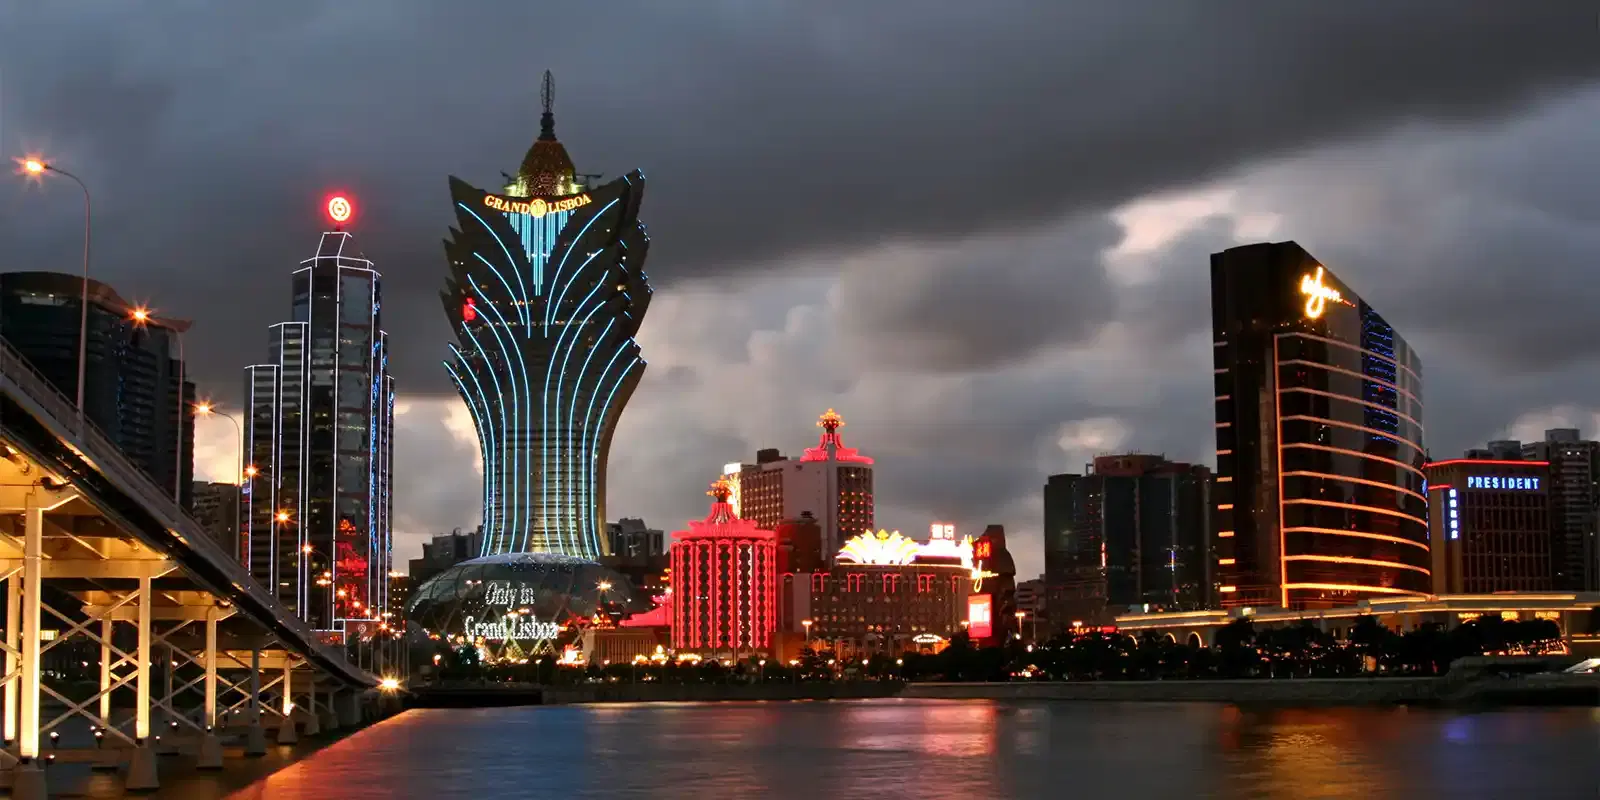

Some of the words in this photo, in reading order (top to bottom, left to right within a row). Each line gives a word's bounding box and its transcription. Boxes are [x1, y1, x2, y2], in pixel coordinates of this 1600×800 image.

[484, 195, 530, 214] GRAND
[547, 194, 592, 213] LISBOA
[1467, 476, 1539, 490] PRESIDENT
[485, 581, 517, 612] Only
[520, 582, 535, 605] in
[465, 615, 507, 642] Grand
[511, 615, 558, 640] Lisboa
